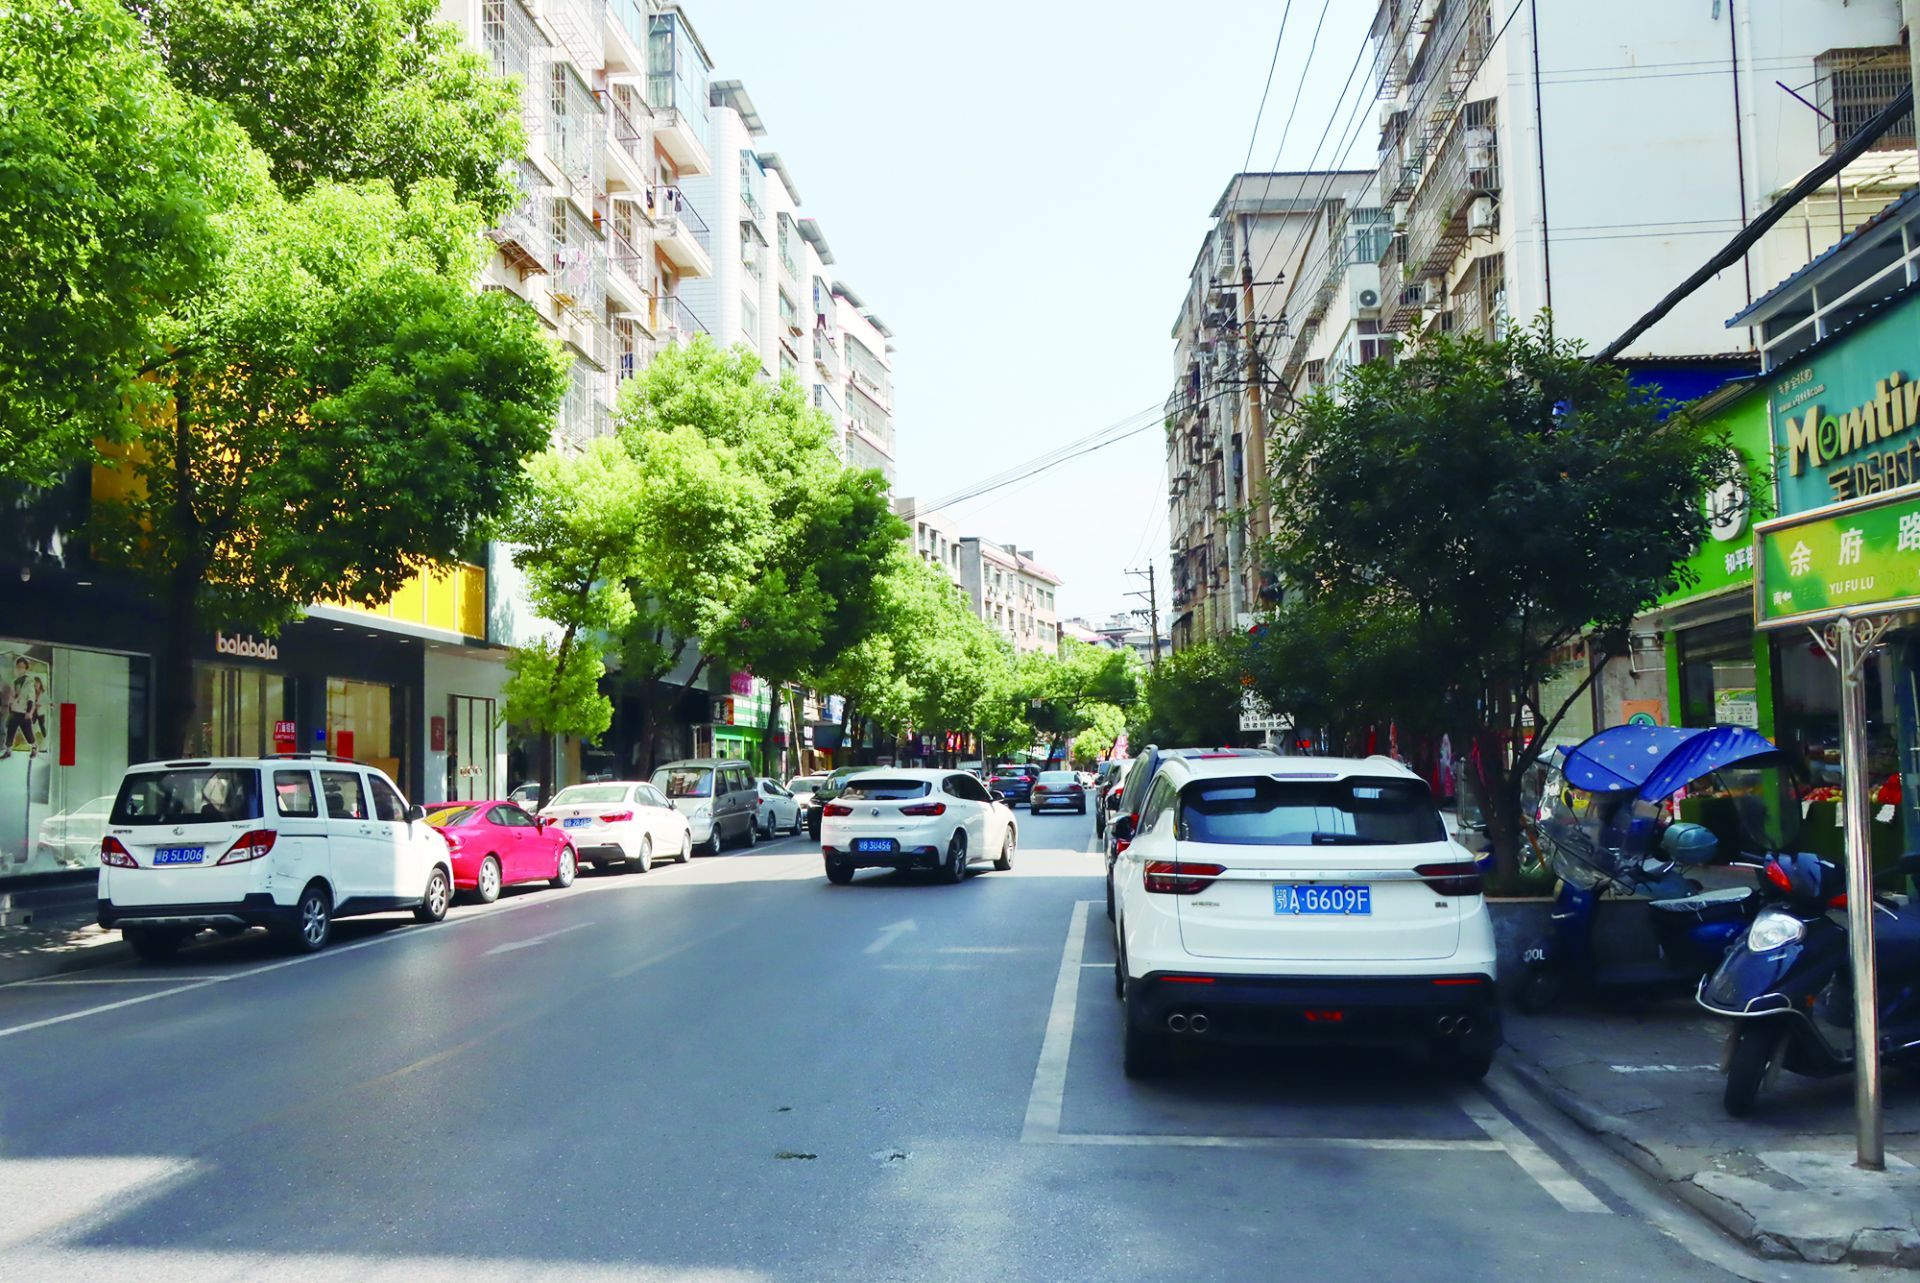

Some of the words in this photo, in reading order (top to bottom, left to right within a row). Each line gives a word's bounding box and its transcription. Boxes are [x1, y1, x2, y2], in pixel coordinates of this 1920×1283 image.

[1790, 511, 1920, 577] 余府路
[1829, 583, 1843, 595] YU
[1845, 579, 1858, 593] FU
[1861, 576, 1874, 589] LU
[216, 630, 278, 660] balabala
